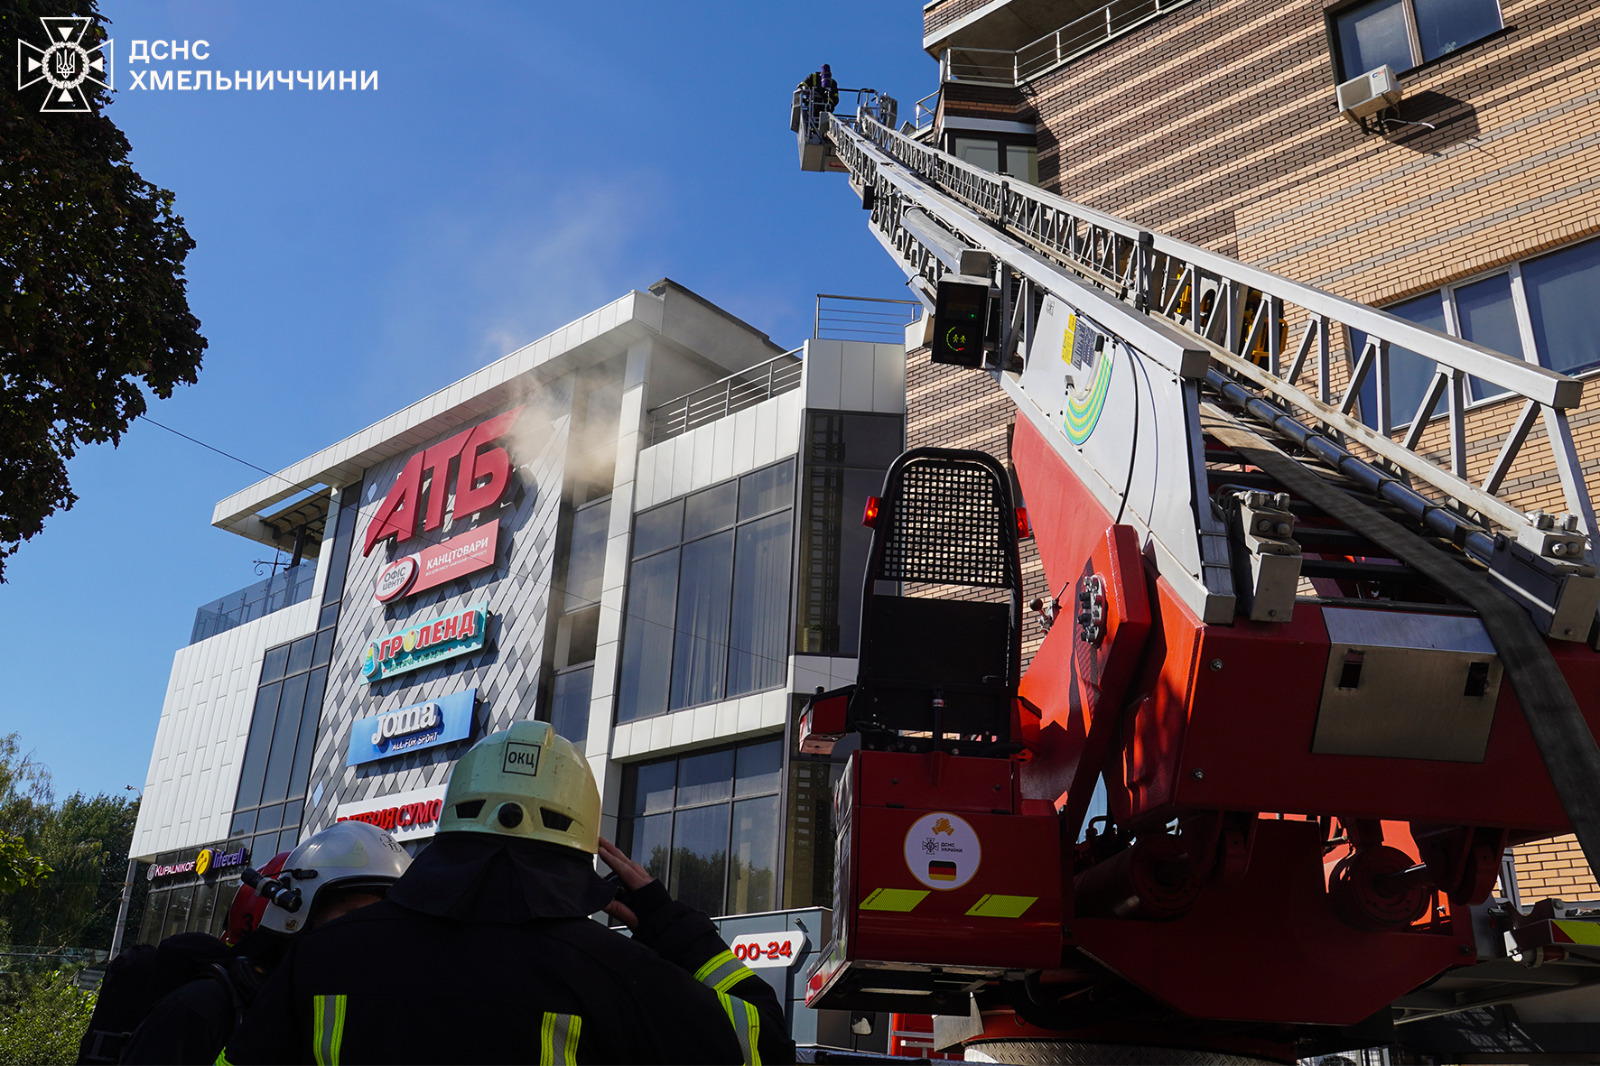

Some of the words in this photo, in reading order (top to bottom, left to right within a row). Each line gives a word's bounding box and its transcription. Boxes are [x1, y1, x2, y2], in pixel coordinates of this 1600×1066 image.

[363, 403, 527, 558] АТБ
[426, 536, 489, 570] КАНЦТОВАРИ
[383, 566, 406, 583] ОФІС
[391, 742, 404, 752] ALL
[404, 738, 417, 748] FOR
[418, 731, 438, 746] SPORT
[508, 751, 534, 769] ОКЦ
[212, 848, 246, 869] lifecell
